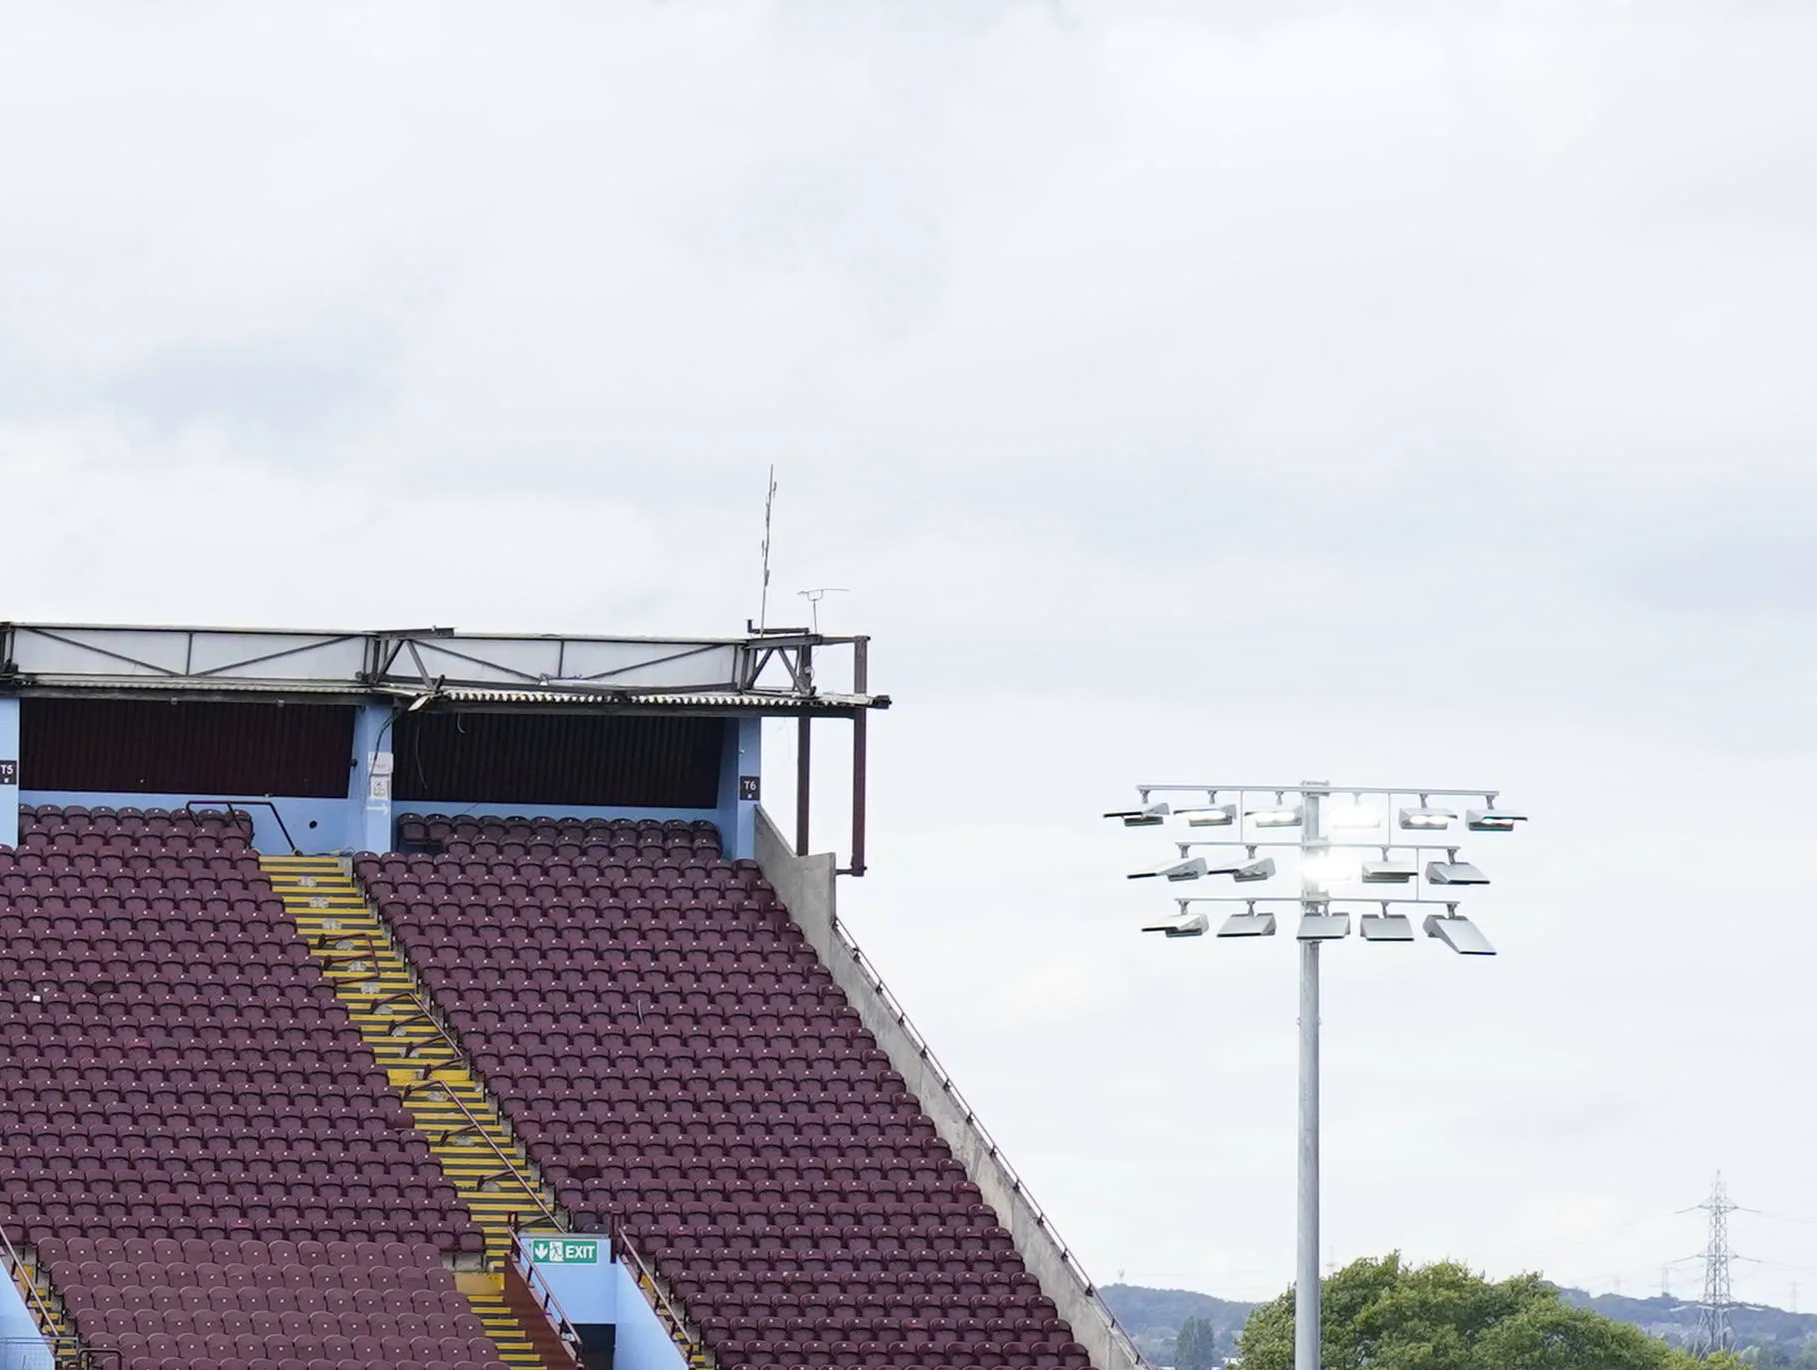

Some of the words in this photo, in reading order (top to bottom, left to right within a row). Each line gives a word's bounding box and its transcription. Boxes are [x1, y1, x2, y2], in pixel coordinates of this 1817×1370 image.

[0, 763, 14, 775] T5
[743, 779, 757, 790] T6
[565, 1245, 596, 1259] EXIT
